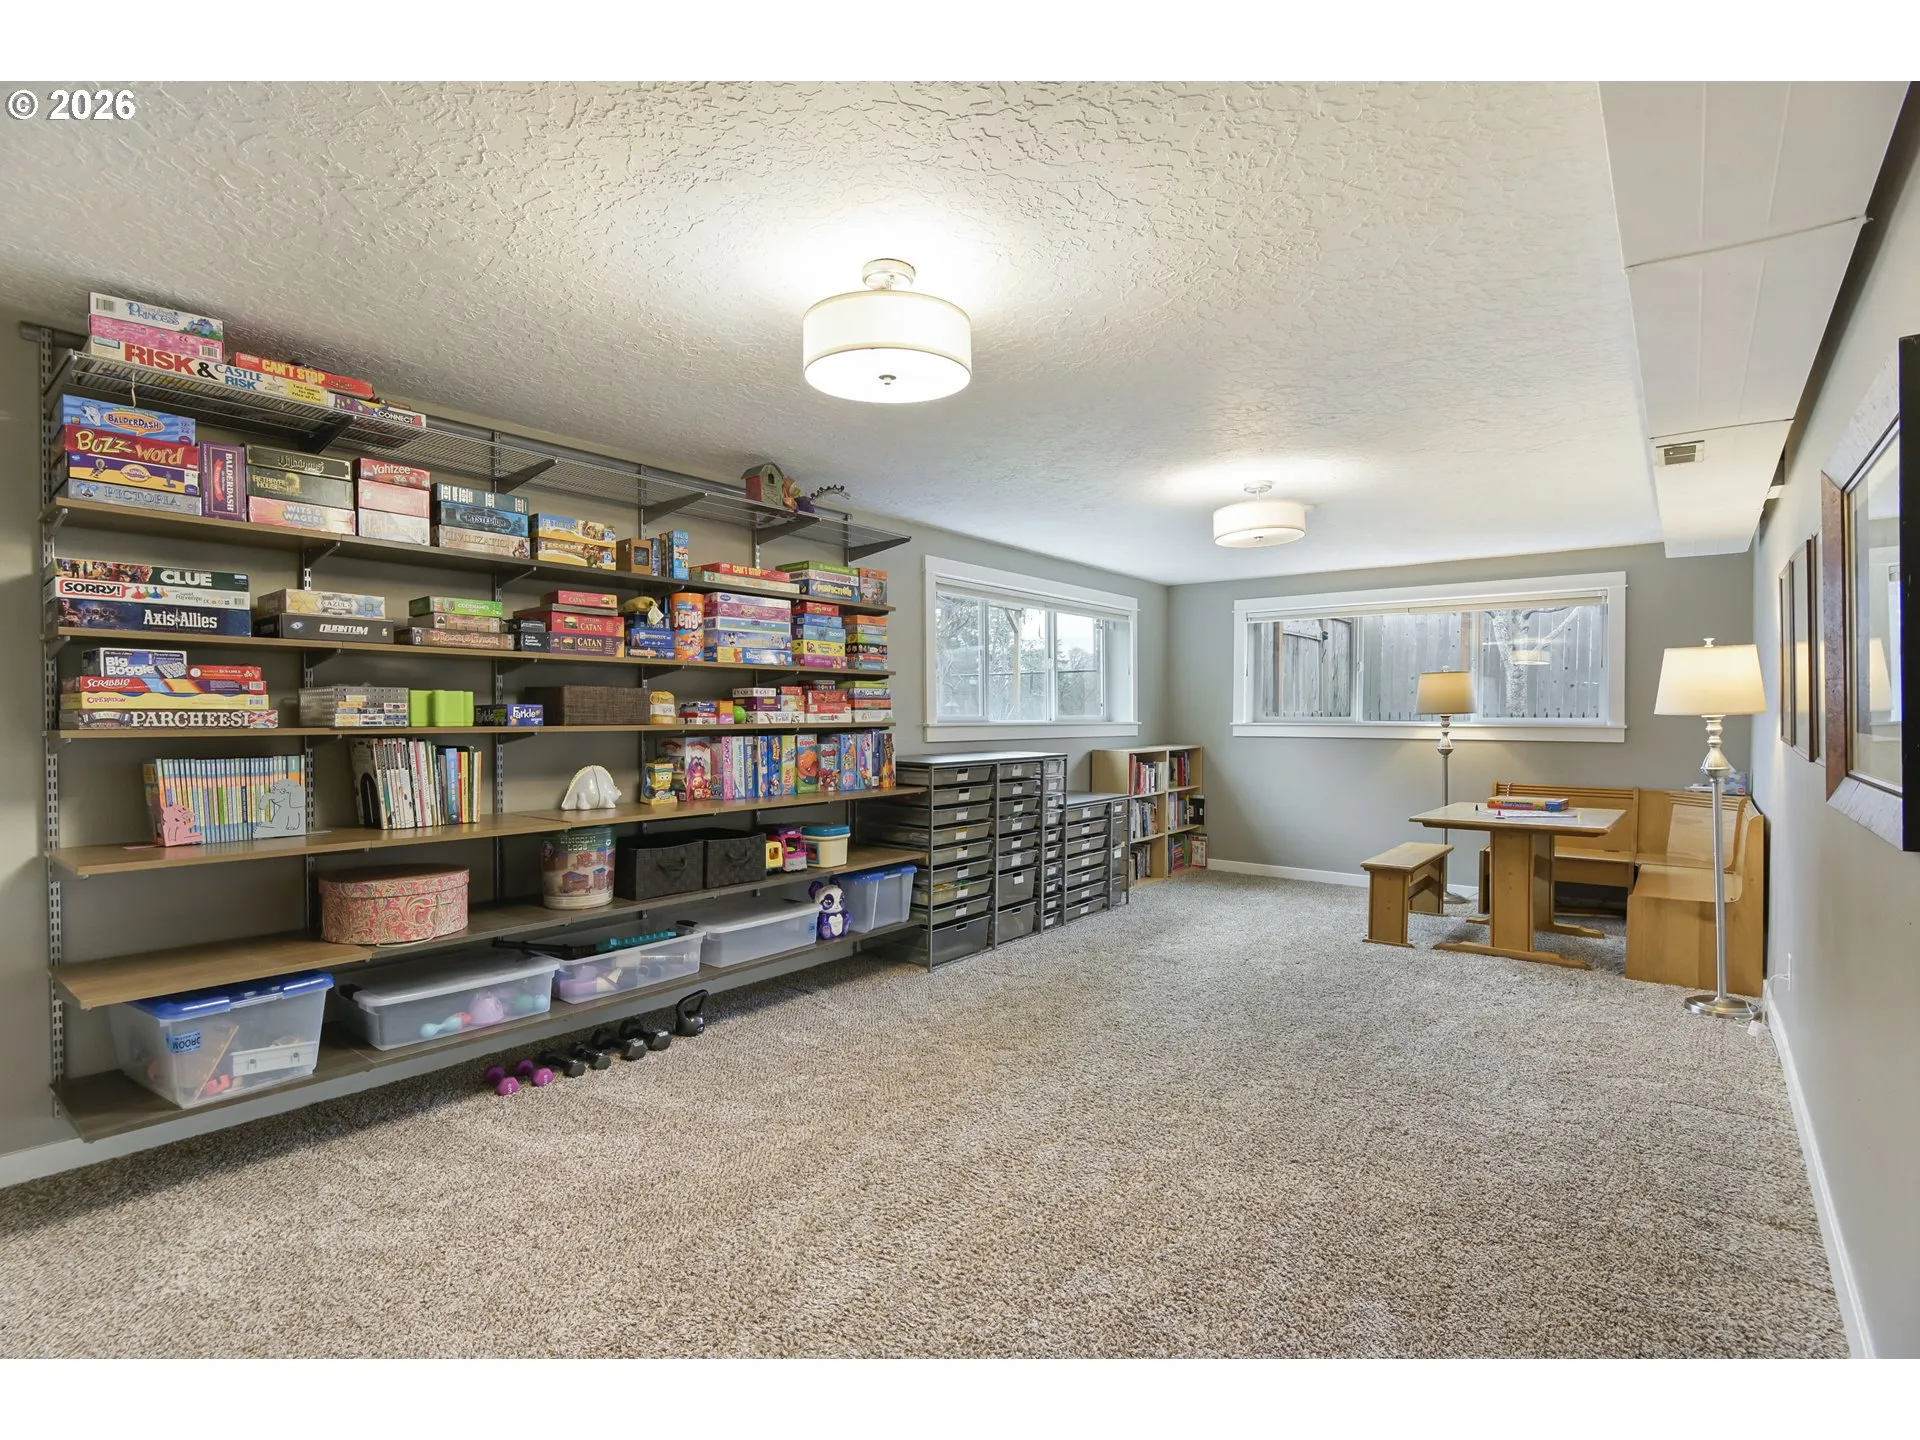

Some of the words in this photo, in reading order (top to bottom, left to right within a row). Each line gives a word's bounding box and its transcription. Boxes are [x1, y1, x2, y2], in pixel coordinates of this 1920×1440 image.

[125, 343, 196, 376] RISK
[197, 361, 219, 381] &
[214, 363, 263, 383] CASTLE
[262, 359, 294, 378] CAN'T
[297, 366, 326, 385] STOP
[224, 374, 257, 391] RISK
[108, 414, 160, 429] BALDERDASH
[379, 410, 414, 424] CONNECT
[372, 463, 411, 475] Yahtzee
[225, 452, 235, 512] BALDERDASH
[104, 486, 180, 507] PICTOPIA
[285, 504, 312, 515] WITS
[283, 511, 326, 525] WAGERS
[466, 514, 505, 527] MYSTERIUM
[445, 530, 516, 549] CIVILIZATION
[160, 570, 212, 587] CLUE
[64, 582, 120, 595] SORRY!
[143, 609, 175, 627] Axis
[180, 611, 218, 629] Allies
[674, 610, 703, 630] Jenga
[319, 623, 369, 635] QUANTUM
[580, 622, 602, 632] CATAN
[577, 637, 602, 647] CATAN
[105, 656, 128, 668] Big
[106, 664, 155, 676] Boggle
[130, 711, 253, 727] PARCHEESI
[512, 706, 536, 719] Farkle
